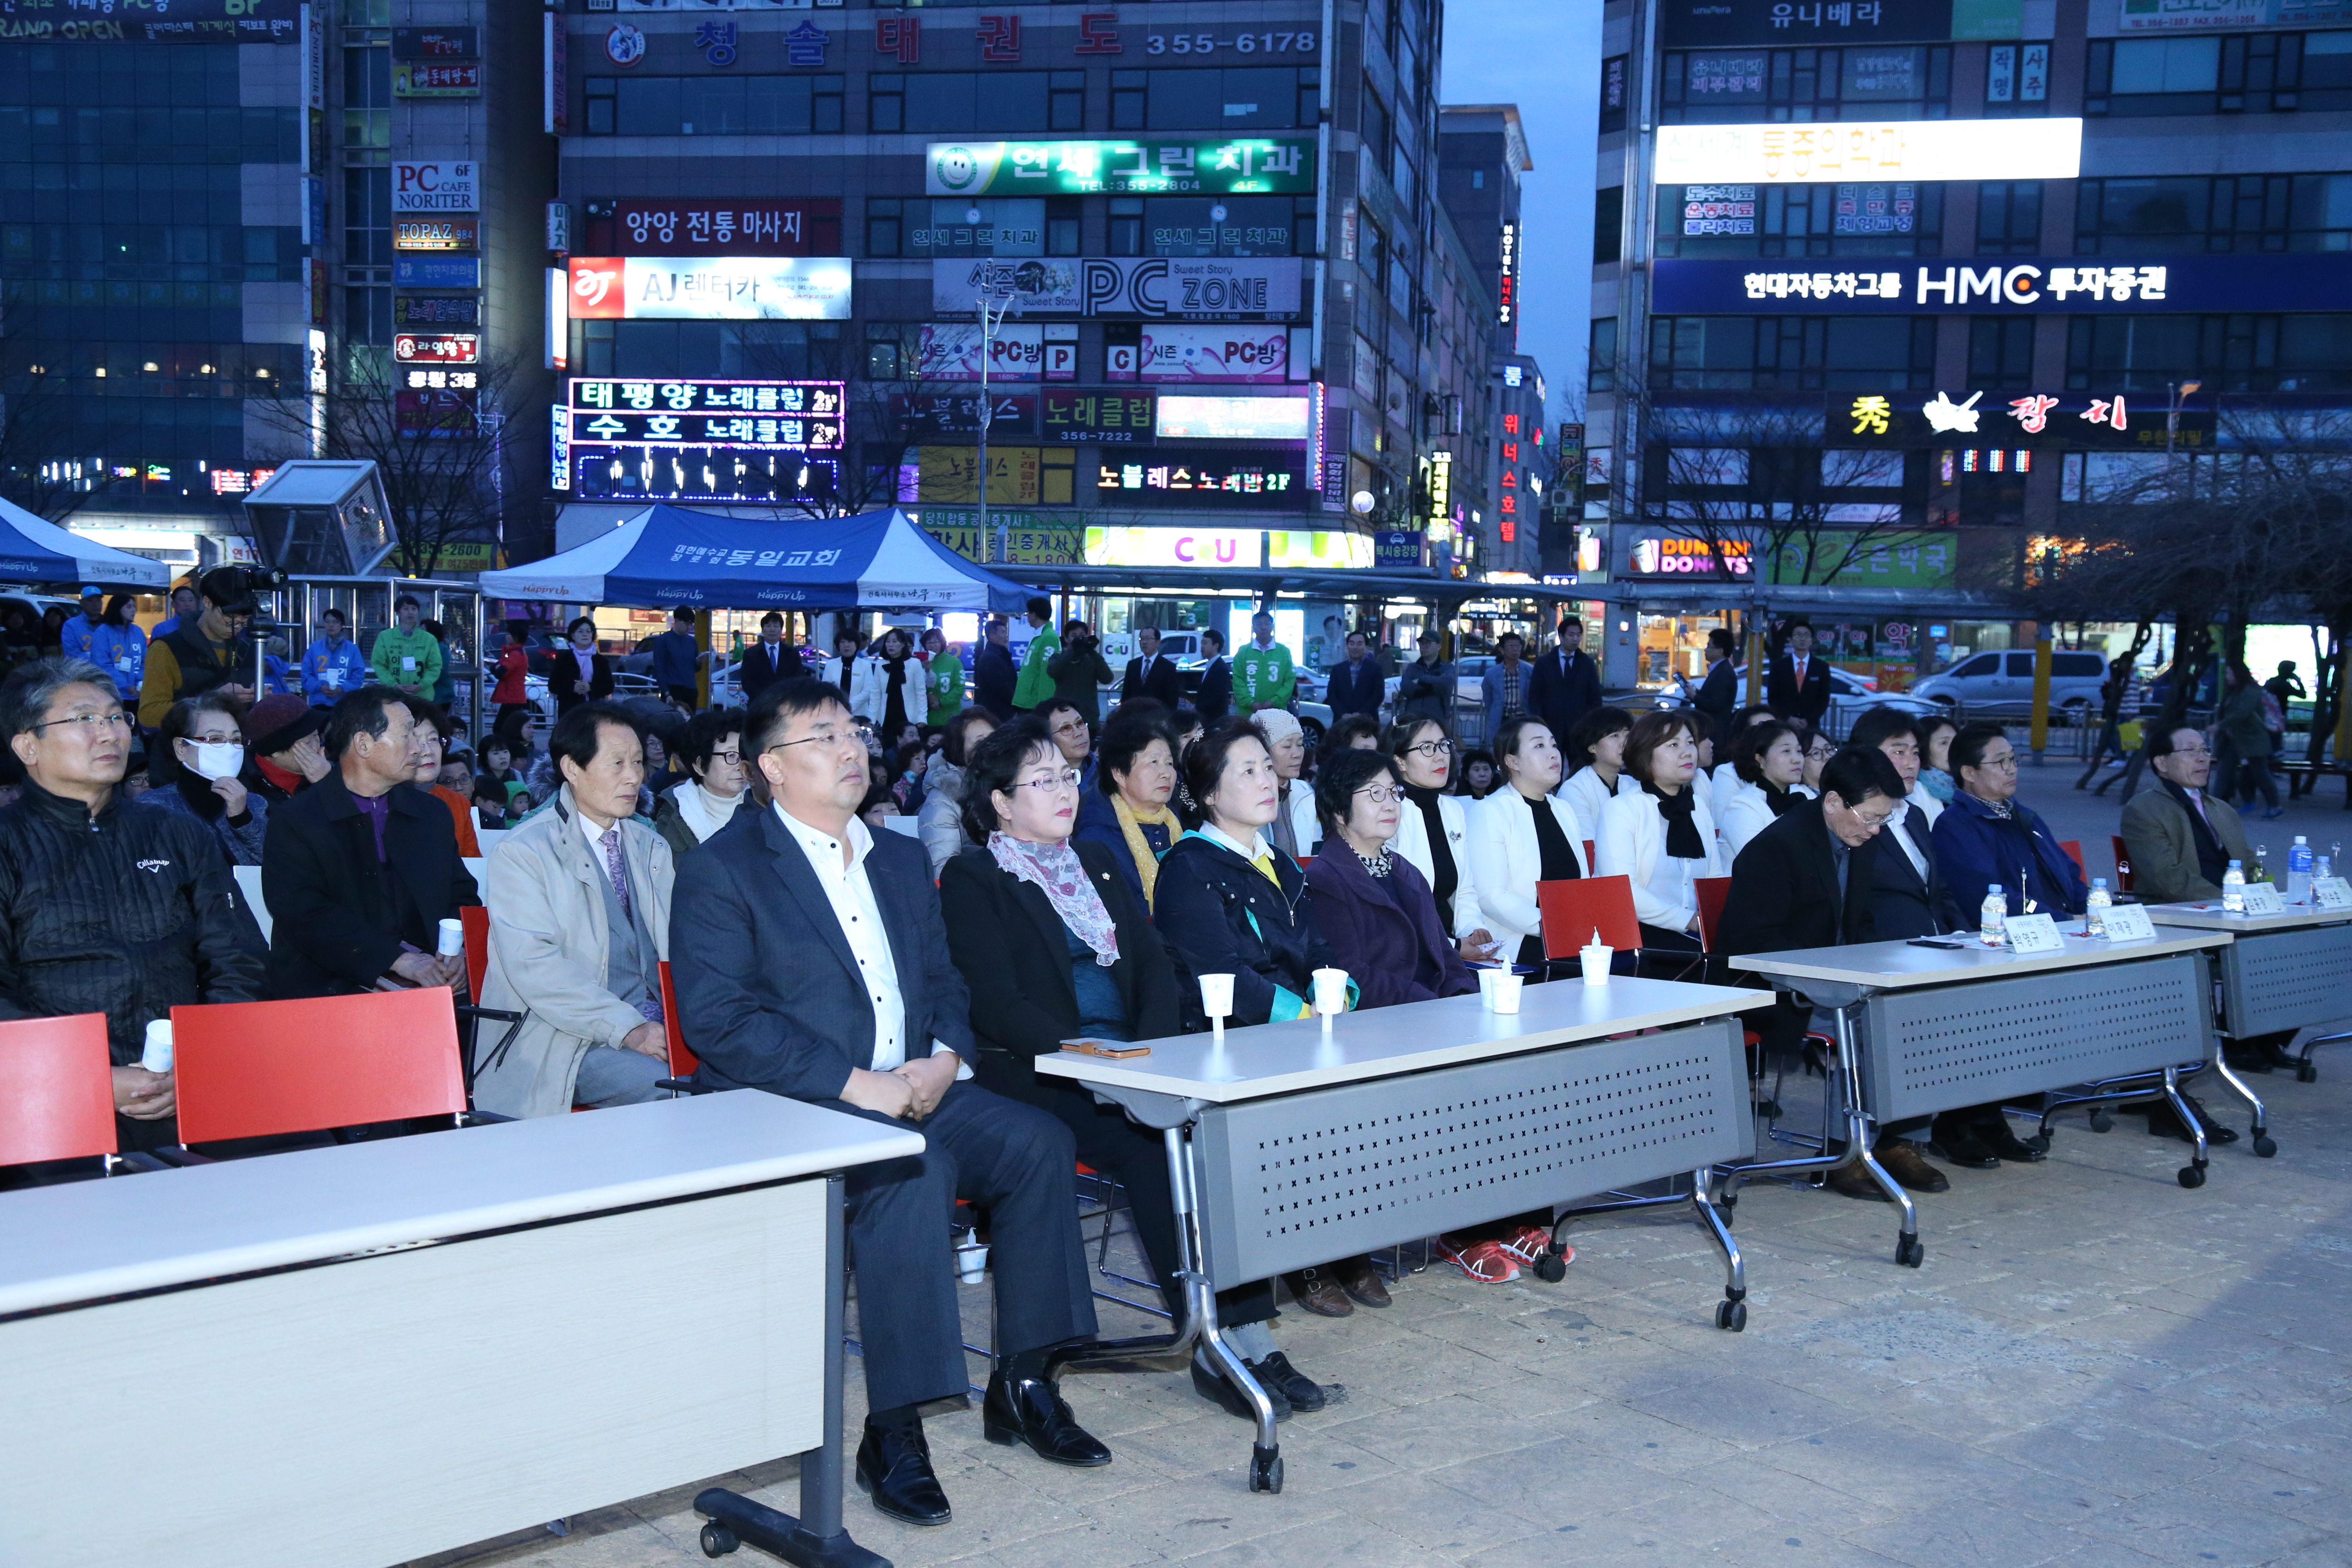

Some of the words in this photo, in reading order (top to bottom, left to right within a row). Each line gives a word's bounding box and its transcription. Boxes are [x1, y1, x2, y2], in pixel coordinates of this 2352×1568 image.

[1770, 1, 1882, 28] 유니베라
[61, 20, 123, 39] OPEN
[695, 20, 829, 66] 청솔
[876, 13, 1123, 63] 태권도
[1147, 32, 1315, 55] 355-6178
[2025, 49, 2044, 96] 사주
[1011, 147, 1094, 178] 연세
[1112, 146, 1195, 177] 그린
[1215, 144, 1303, 176] 치과
[1762, 127, 1906, 178] 통증의학과
[397, 165, 439, 192] PC
[455, 164, 471, 177] 6F
[441, 181, 471, 192] CAFE
[399, 194, 473, 208] NORITER
[1685, 186, 1756, 201] 도수치료
[1685, 201, 1755, 218] 운동치료
[399, 223, 453, 240] TOPAZ
[456, 229, 473, 240] 984
[686, 211, 737, 243] 전통
[742, 211, 802, 243] 마사지
[1836, 216, 1913, 233] 체형교정
[912, 229, 950, 246] 연세
[955, 228, 994, 246] 그린
[1000, 227, 1039, 245] 치과
[1154, 228, 1191, 245] 연세
[1196, 228, 1236, 245] 그린
[1246, 227, 1288, 245] 치과
[1502, 224, 1514, 276] HOTEL
[1174, 264, 1204, 274] Sweet
[1205, 264, 1233, 276] Story
[642, 273, 679, 301] AJ
[684, 273, 760, 302] 렌터카
[1081, 259, 1168, 316] PC
[1181, 278, 1268, 310] ZONE
[1744, 272, 1901, 299] 현대자동차그룹
[1917, 264, 2042, 305] HMC
[2046, 266, 2167, 302] 투자증권
[1023, 297, 1052, 306] Sweet
[1054, 297, 1081, 309] Story
[993, 340, 1043, 363] PC방
[1055, 349, 1069, 370] P
[1114, 349, 1130, 370] C
[1152, 345, 1177, 359] 시즌
[1225, 342, 1277, 365] PC방
[581, 382, 697, 410] 태평양
[705, 387, 804, 411] 노래클럽
[1046, 397, 1152, 427] 노래클럽
[1167, 399, 1294, 428] 노블레스
[1850, 395, 1891, 435] 秀
[2007, 393, 2127, 434] 참치
[587, 415, 682, 440] 수호
[705, 419, 804, 442] 노래클럽
[1060, 431, 1132, 441] 356-7222
[1098, 465, 1193, 489] 노블레스
[1266, 473, 1290, 491] 2F
[1500, 413, 1519, 543] 위너스호텔
[925, 511, 967, 526] 당진합동
[670, 552, 722, 564] 장로회
[725, 549, 843, 567] 동일교회
[674, 544, 729, 557] 대한예수교
[1376, 544, 1419, 558] 택시승강장
[523, 584, 555, 594] Happy
[555, 585, 570, 596] Up
[656, 588, 689, 599] Happy
[689, 589, 704, 600] Up
[757, 589, 791, 600] Happy
[791, 590, 806, 601] Up
[1186, 612, 1197, 625] 3
[1044, 645, 1056, 658] 3
[316, 655, 328, 672] 2
[1268, 665, 1279, 682] 3
[939, 676, 951, 693] 3
[137, 859, 170, 870] Callaway
[2107, 921, 2134, 936] 이재광
[2014, 931, 2040, 948] 박영규
